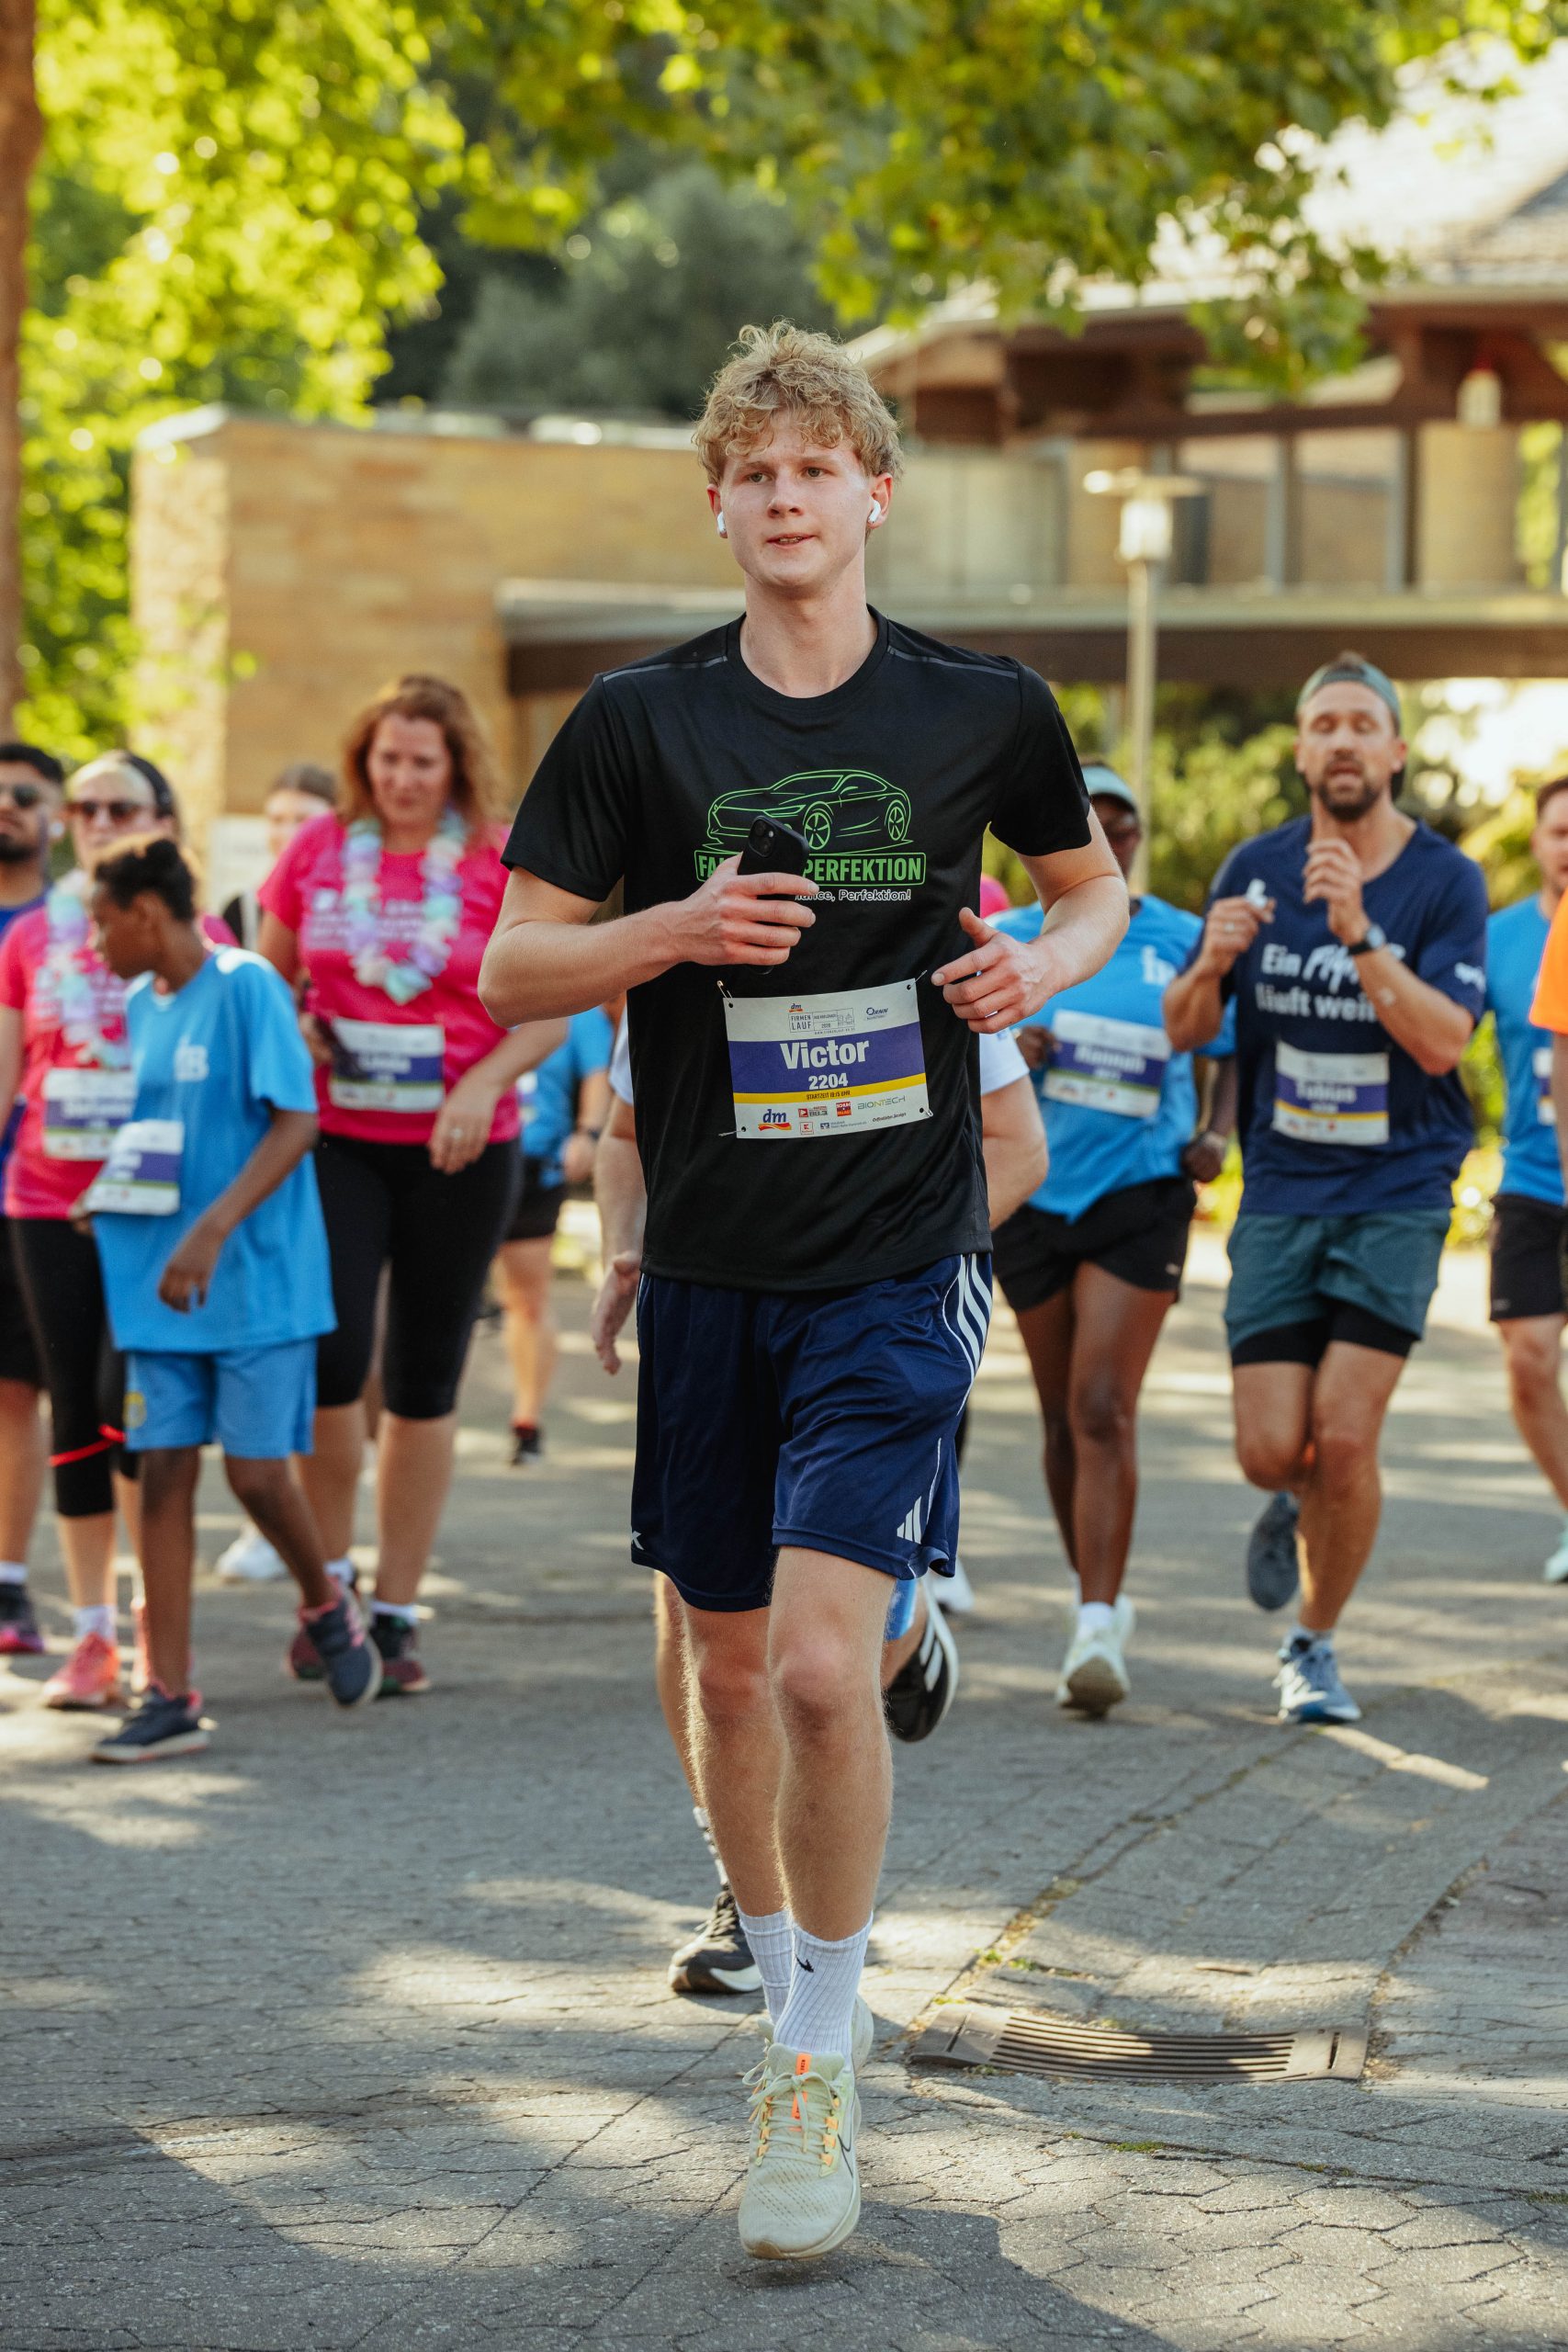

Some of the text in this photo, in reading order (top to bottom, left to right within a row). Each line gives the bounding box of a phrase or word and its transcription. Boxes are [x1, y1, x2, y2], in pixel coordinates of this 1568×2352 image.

[801, 857, 921, 882] PERFEKTION
[839, 888, 911, 901] Perfektion!
[1261, 943, 1302, 977] Ein
[1314, 990, 1379, 1023] wei
[791, 1021, 812, 1030] LAUF
[780, 1039, 870, 1069] Victor
[808, 1072, 849, 1091] 2204
[807, 1091, 829, 1101] STARTZEIT
[857, 1095, 906, 1110] BIONTECH
[762, 1108, 786, 1123] dm
